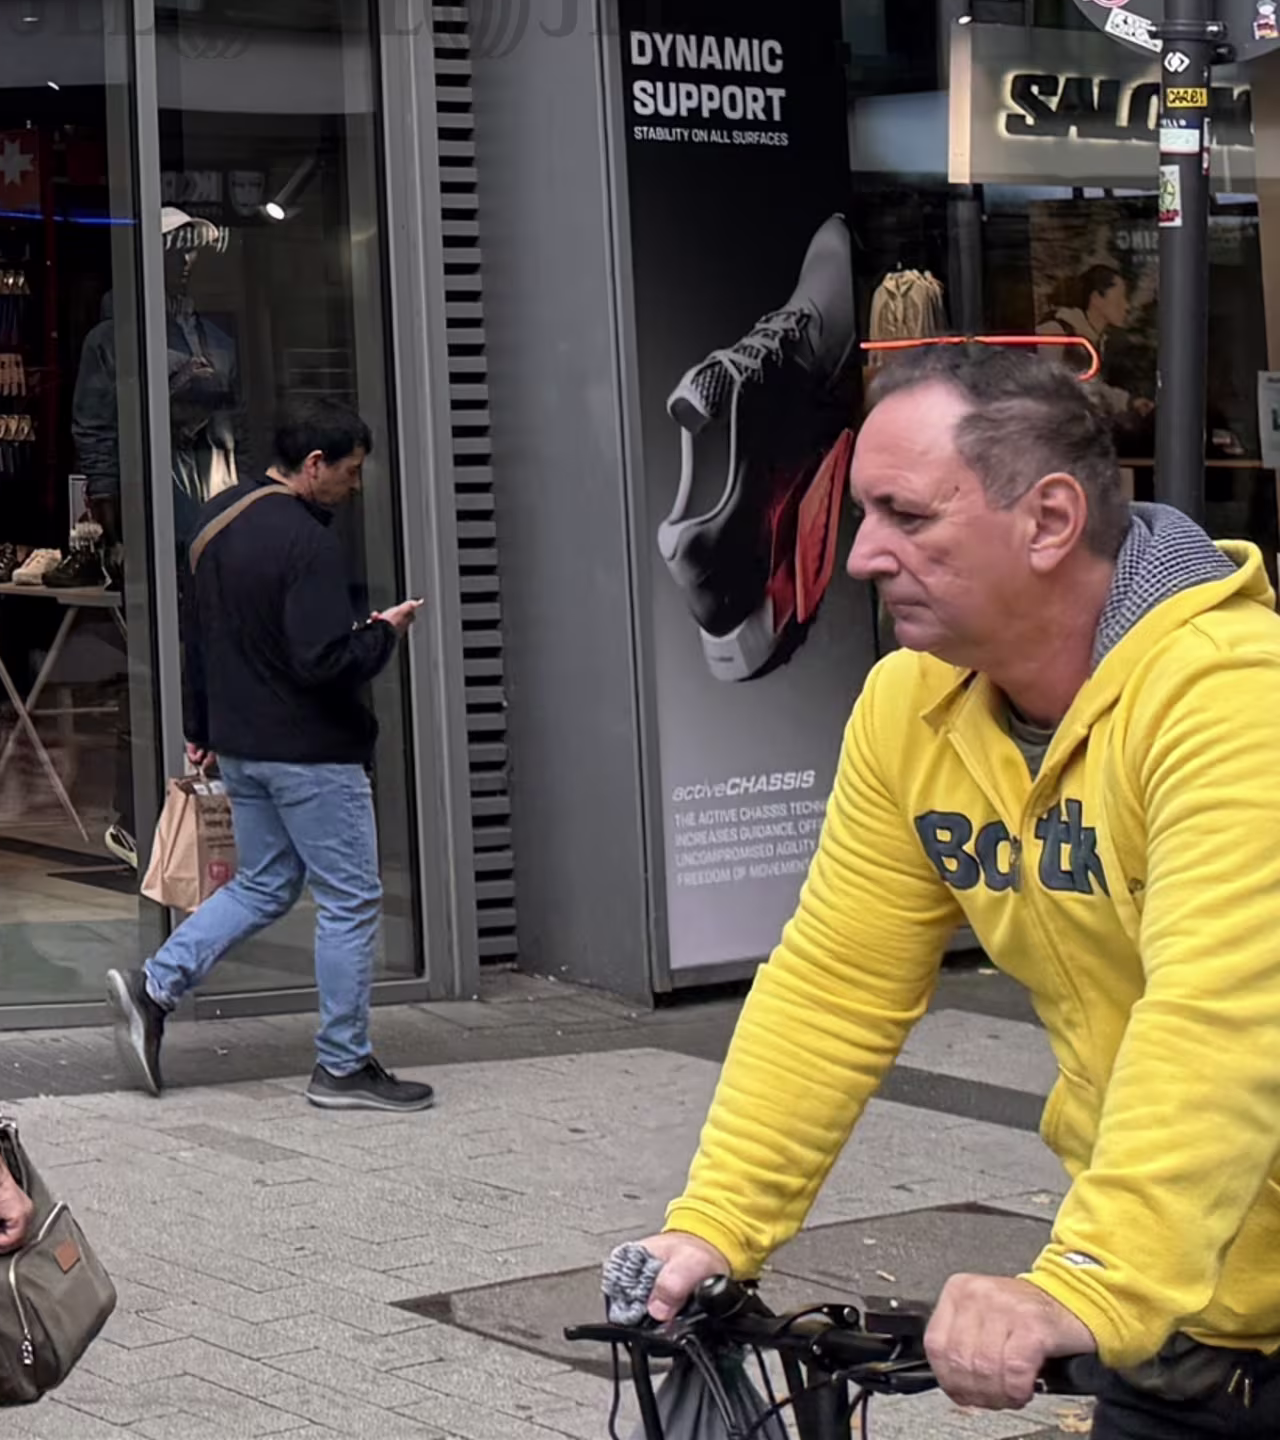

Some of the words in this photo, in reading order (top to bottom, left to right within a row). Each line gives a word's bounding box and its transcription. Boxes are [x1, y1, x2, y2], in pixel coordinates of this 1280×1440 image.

[630, 30, 783, 74] DYNAMIC
[632, 80, 786, 121] SUPPORT
[634, 126, 689, 141] STABILITY
[692, 129, 708, 142] ON
[710, 129, 731, 144] ALL
[732, 130, 789, 146] SURFACES
[672, 770, 816, 801] activeCHASSIS
[675, 812, 697, 827] THE
[698, 808, 738, 825] ACTIVE
[740, 803, 788, 821] CHASSIS
[675, 826, 738, 846] INCREASES
[798, 818, 820, 834] OFF
[676, 867, 732, 886] FREEDOM
[733, 865, 746, 880] OF
